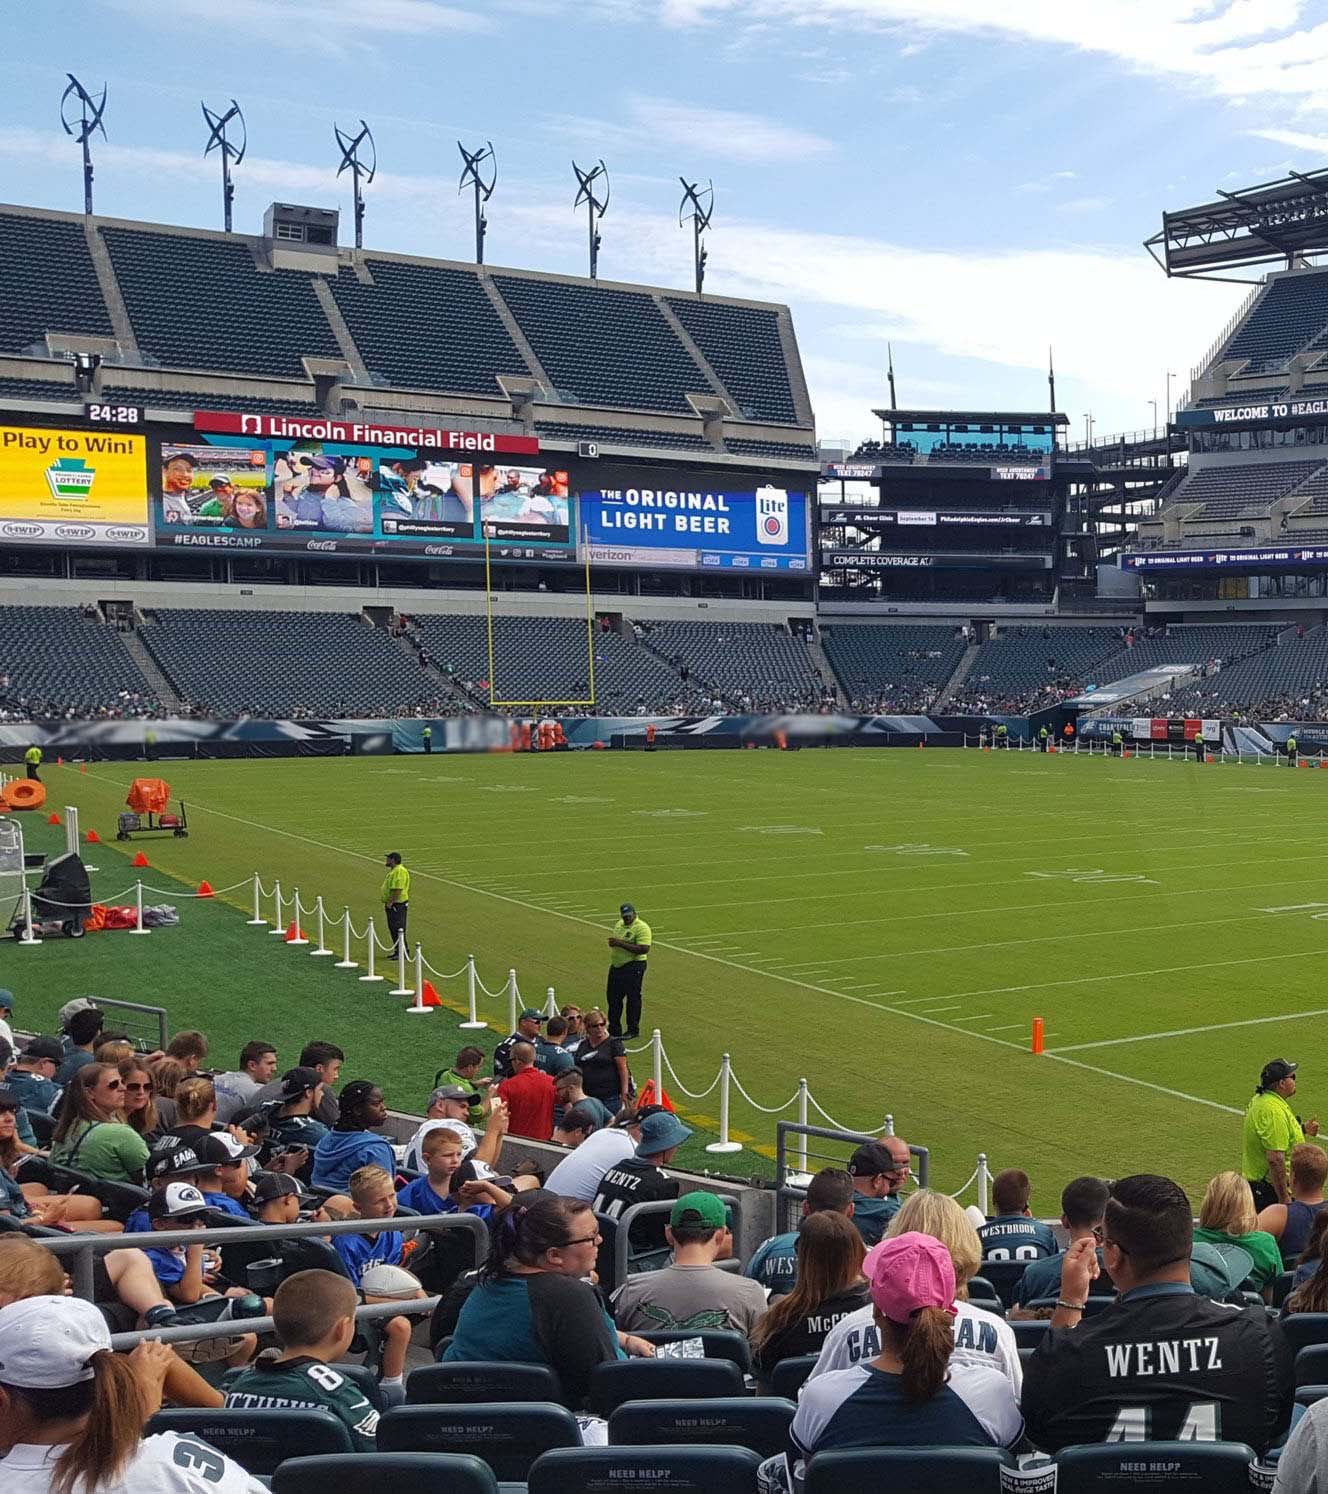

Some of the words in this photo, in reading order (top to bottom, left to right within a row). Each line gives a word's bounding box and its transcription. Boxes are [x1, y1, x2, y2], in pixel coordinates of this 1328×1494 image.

[90, 404, 138, 423] 24:28
[1213, 406, 1269, 422] WELCOME
[1272, 404, 1287, 417] TO
[270, 416, 346, 440] Lincoln
[353, 427, 442, 448] Financial
[449, 432, 495, 451] Field
[2, 431, 52, 454] Play
[56, 436, 79, 452] to
[84, 438, 134, 455] Win!
[589, 444, 596, 456] 0
[55, 477, 92, 485] LOTTERY
[600, 489, 623, 499] THE
[625, 489, 730, 512] ORIGINAL
[759, 498, 786, 515] Lite
[601, 510, 667, 531] LIGHT
[675, 515, 730, 534] BEER
[174, 535, 262, 548] #EAGLESCAMP
[589, 550, 632, 562] verizon
[833, 556, 876, 565] COMPLETE
[876, 556, 919, 566] COVERAGE
[981, 1223, 1036, 1238] WESTBROOK
[765, 1256, 799, 1276] WES
[1105, 1337, 1223, 1378] WENTZ
[307, 1364, 344, 1392] 8
[203, 1428, 226, 1436] NEED
[227, 1427, 256, 1437] HELP?
[608, 1469, 636, 1478] NEED
[638, 1469, 672, 1478] HELP?
[1119, 1462, 1147, 1472] NEED
[1149, 1462, 1181, 1472] HELP?
